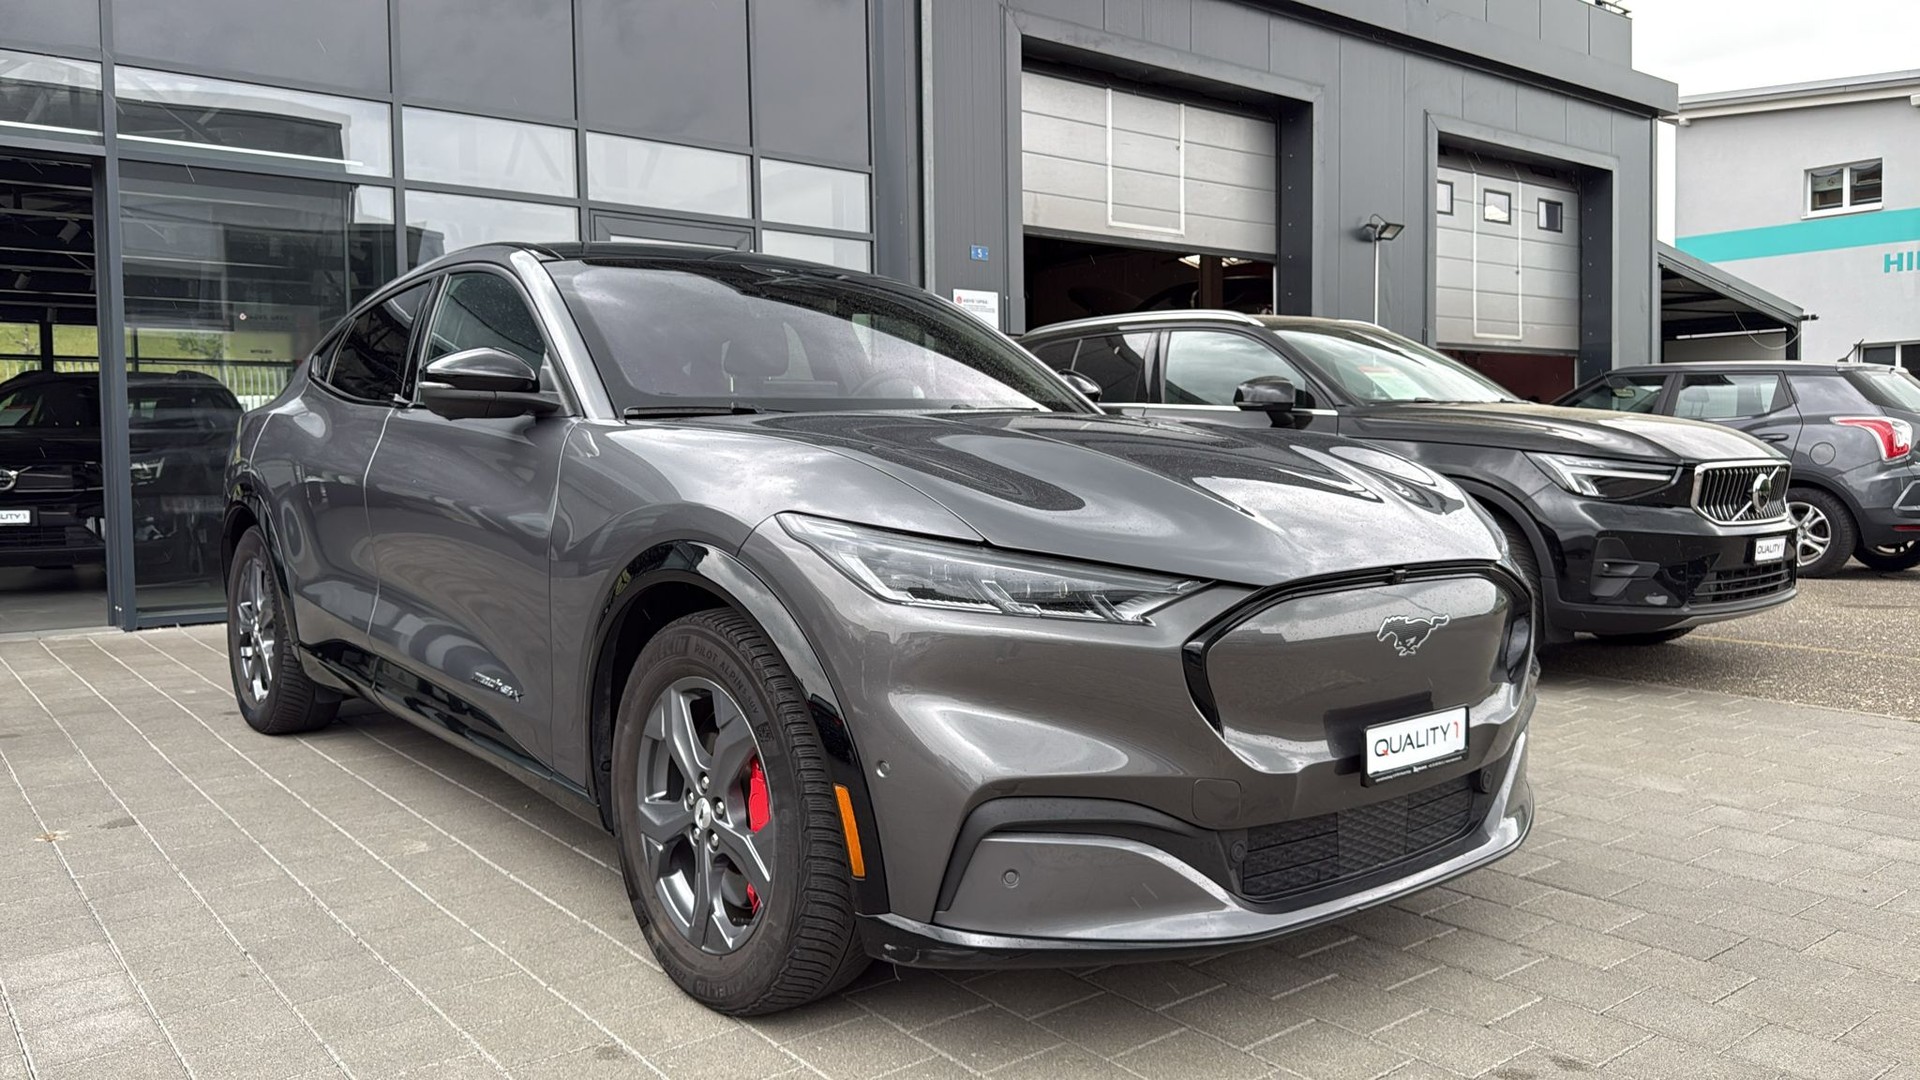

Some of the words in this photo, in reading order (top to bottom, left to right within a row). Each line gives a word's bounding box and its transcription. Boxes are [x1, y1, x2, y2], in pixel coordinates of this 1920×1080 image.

[977, 248, 983, 258] 5
[1757, 543, 1780, 554] QUALITY
[694, 644, 718, 662] PILOT
[1374, 723, 1451, 757] QUALITY
[1453, 721, 1459, 738] 1
